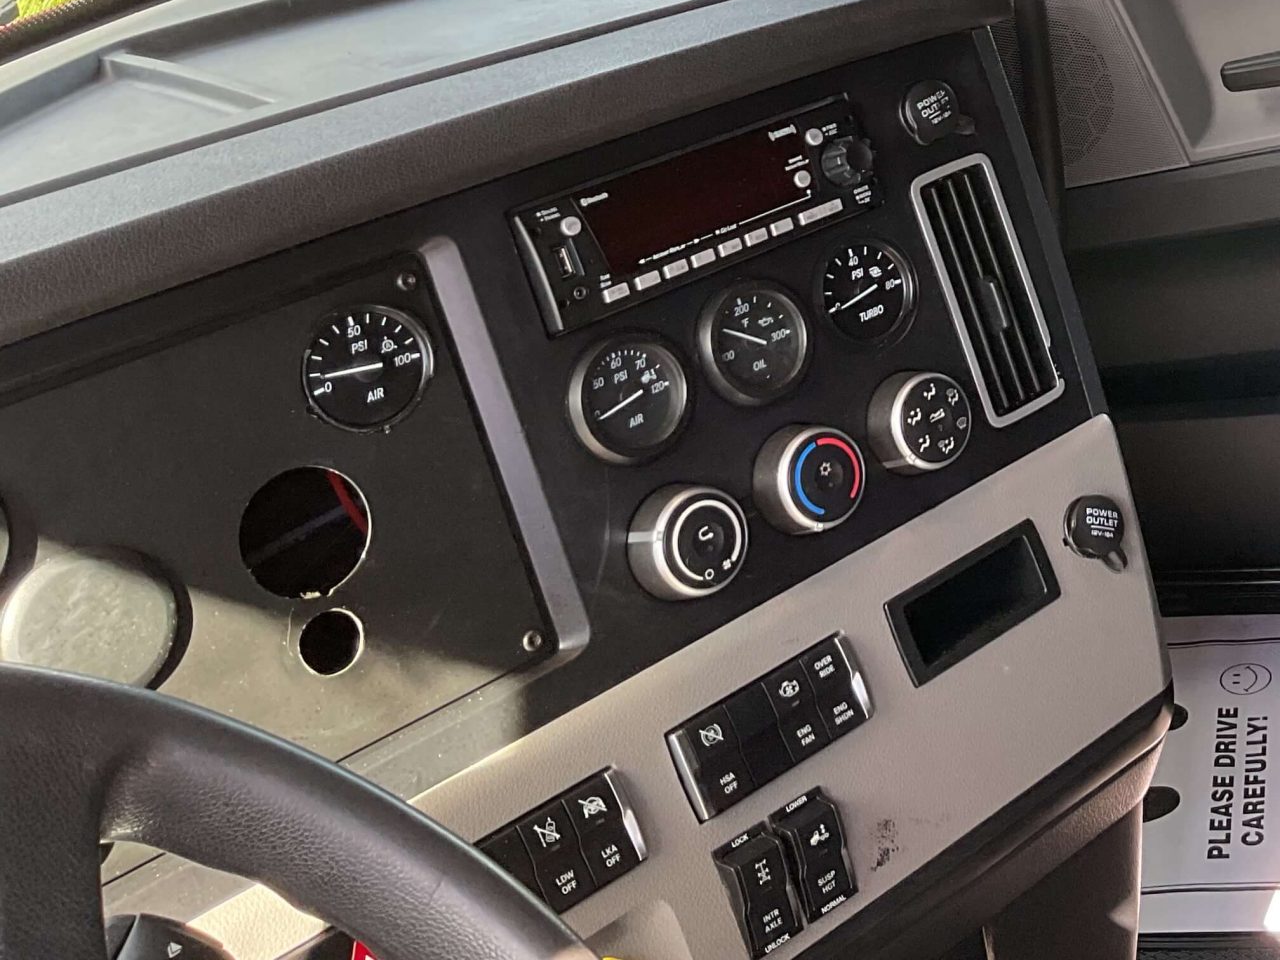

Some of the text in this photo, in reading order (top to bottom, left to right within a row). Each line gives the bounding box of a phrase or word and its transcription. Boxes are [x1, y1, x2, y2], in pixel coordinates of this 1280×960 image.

[848, 255, 859, 267] 40
[851, 267, 864, 280] PSI
[734, 302, 750, 317] 200
[859, 304, 884, 322] TURBO
[348, 324, 361, 338] 50
[771, 328, 786, 342] 300
[351, 339, 368, 355] PSI
[394, 352, 411, 367] 100
[610, 357, 622, 370] 60
[635, 358, 646, 370] 70
[752, 358, 767, 372] OIL
[593, 376, 605, 390] 50
[614, 369, 628, 384] PSI
[323, 381, 333, 393] 0
[366, 386, 385, 403] AIR
[651, 380, 664, 394] 120
[629, 413, 644, 428] AIR
[1086, 507, 1118, 519] POWER
[1086, 515, 1118, 528] OUTLET
[814, 654, 833, 670] OVER
[801, 732, 815, 746] FAN
[720, 771, 736, 786] HSA
[1207, 706, 1239, 860] PLEASE DRIVE
[1241, 715, 1268, 847] CAREFULLY!
[724, 780, 738, 794] OFF
[785, 795, 807, 813] LOWER
[731, 832, 749, 848] LOCK
[601, 844, 618, 858] LKA
[606, 853, 620, 867] OFF
[555, 869, 574, 886] LDW
[817, 870, 836, 887] SUSP
[561, 880, 577, 894] OFF
[821, 894, 847, 914] NORMAL
[763, 908, 780, 923] INTR
[765, 917, 783, 933] AXLE
[764, 932, 790, 954] UNLOCK
